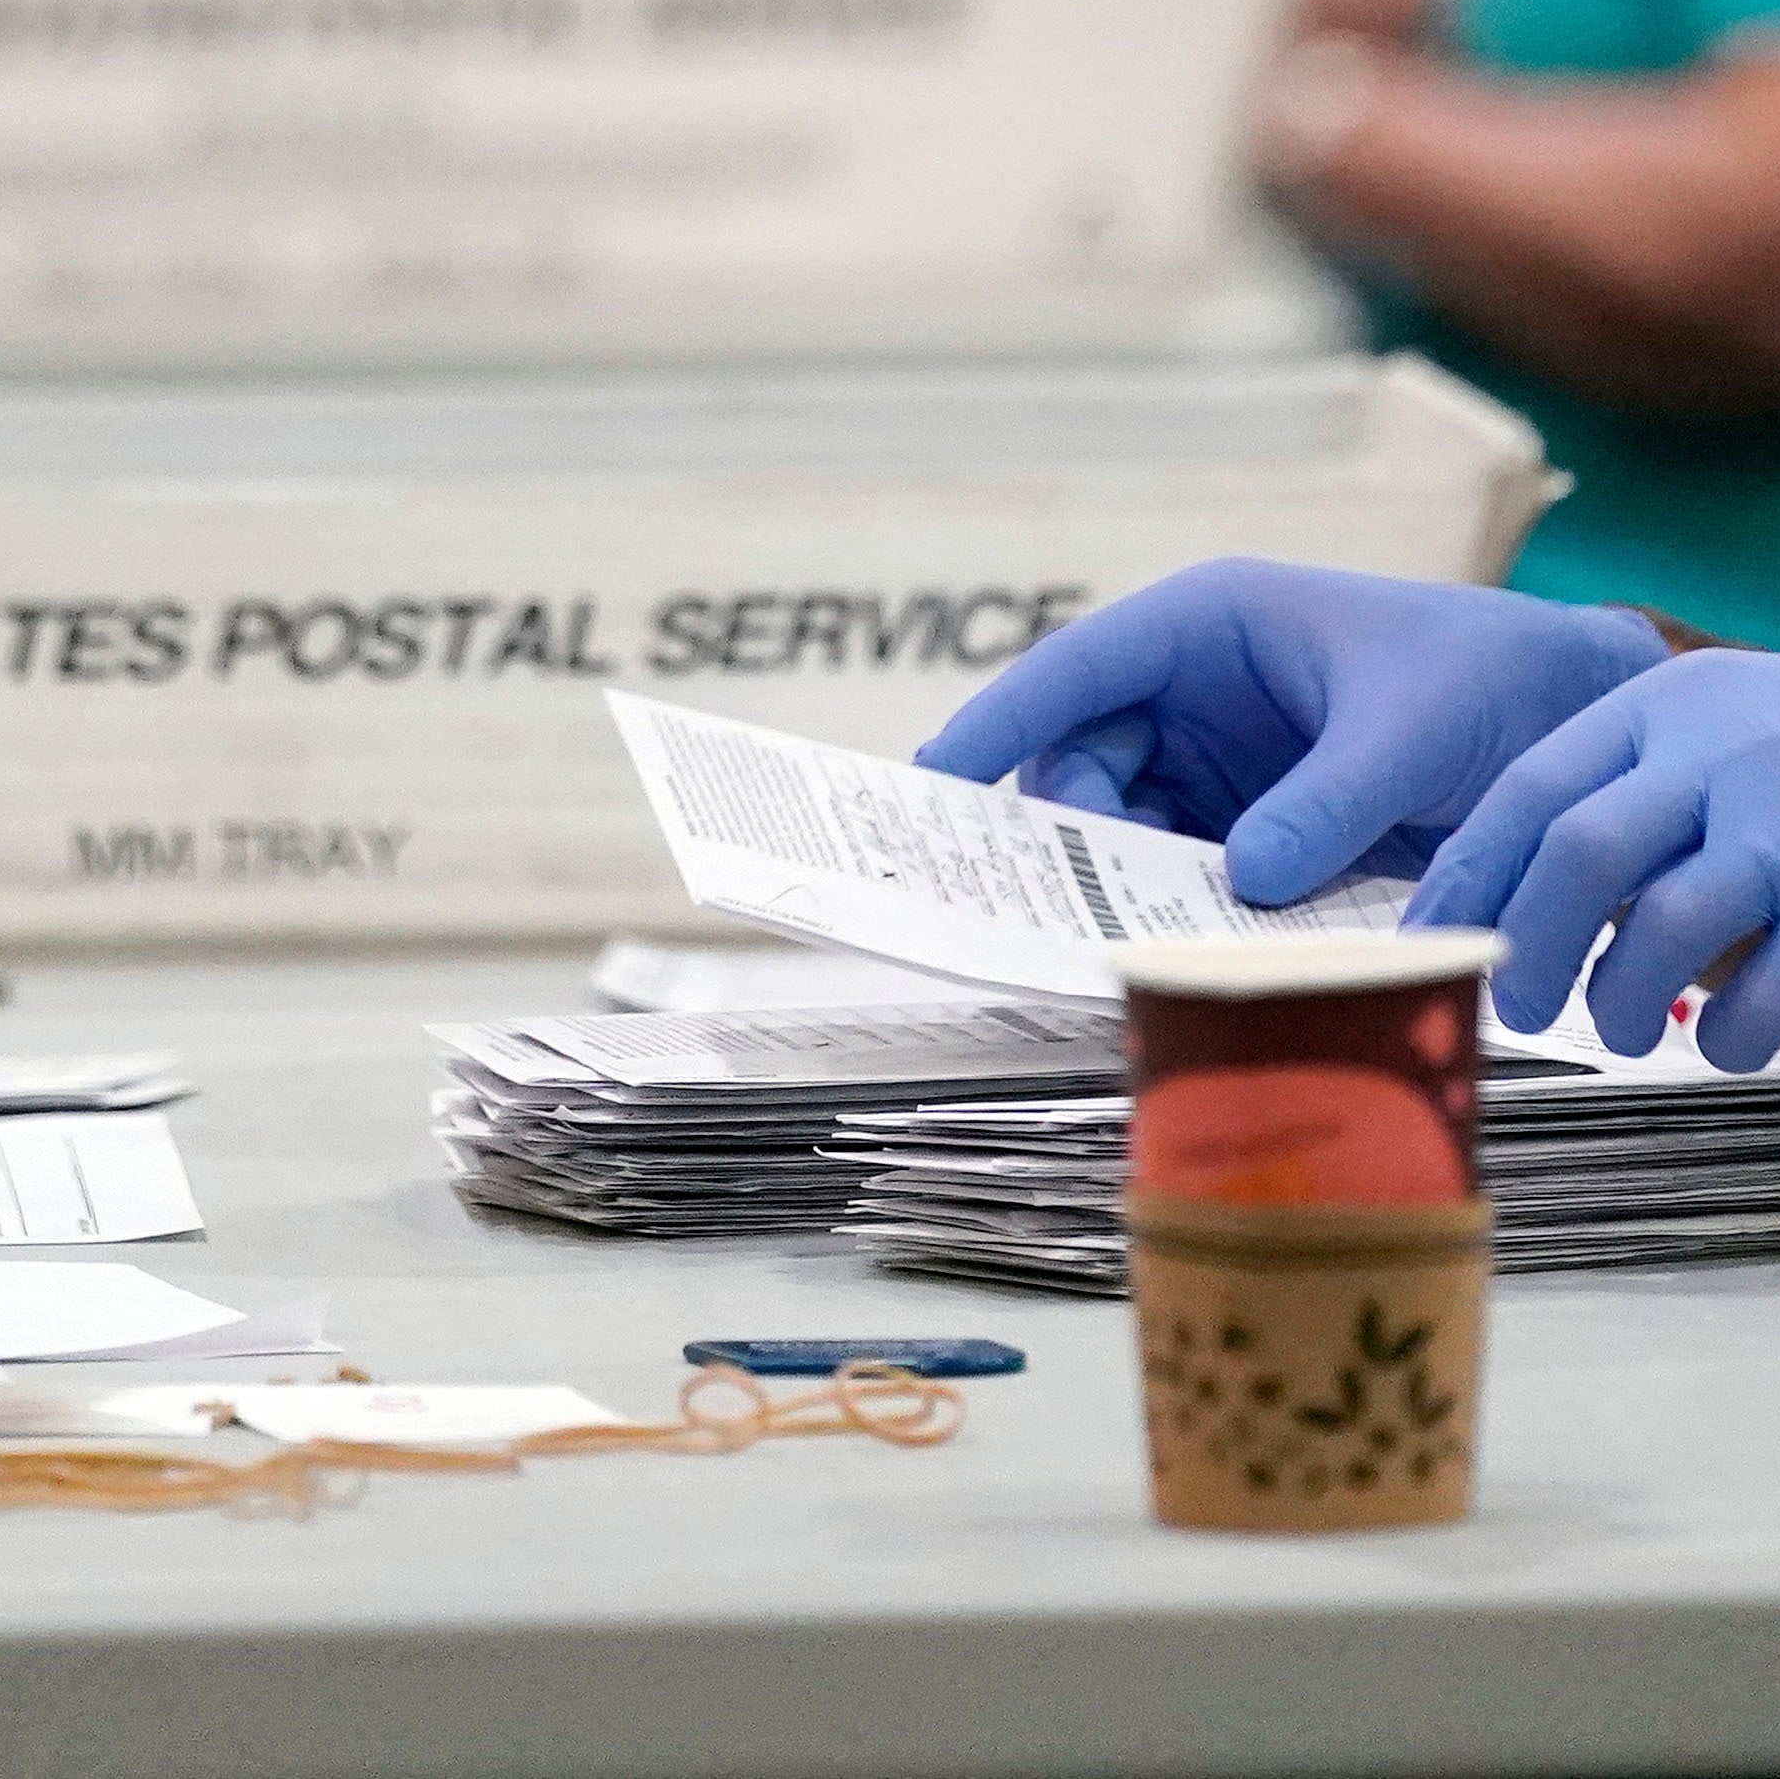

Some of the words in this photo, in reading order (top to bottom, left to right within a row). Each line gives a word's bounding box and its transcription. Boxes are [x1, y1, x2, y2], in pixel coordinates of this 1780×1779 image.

[212, 593, 621, 683] POSTAL
[643, 578, 1092, 679] SERVICE
[74, 825, 196, 881] MM
[217, 819, 413, 881] TRAY
